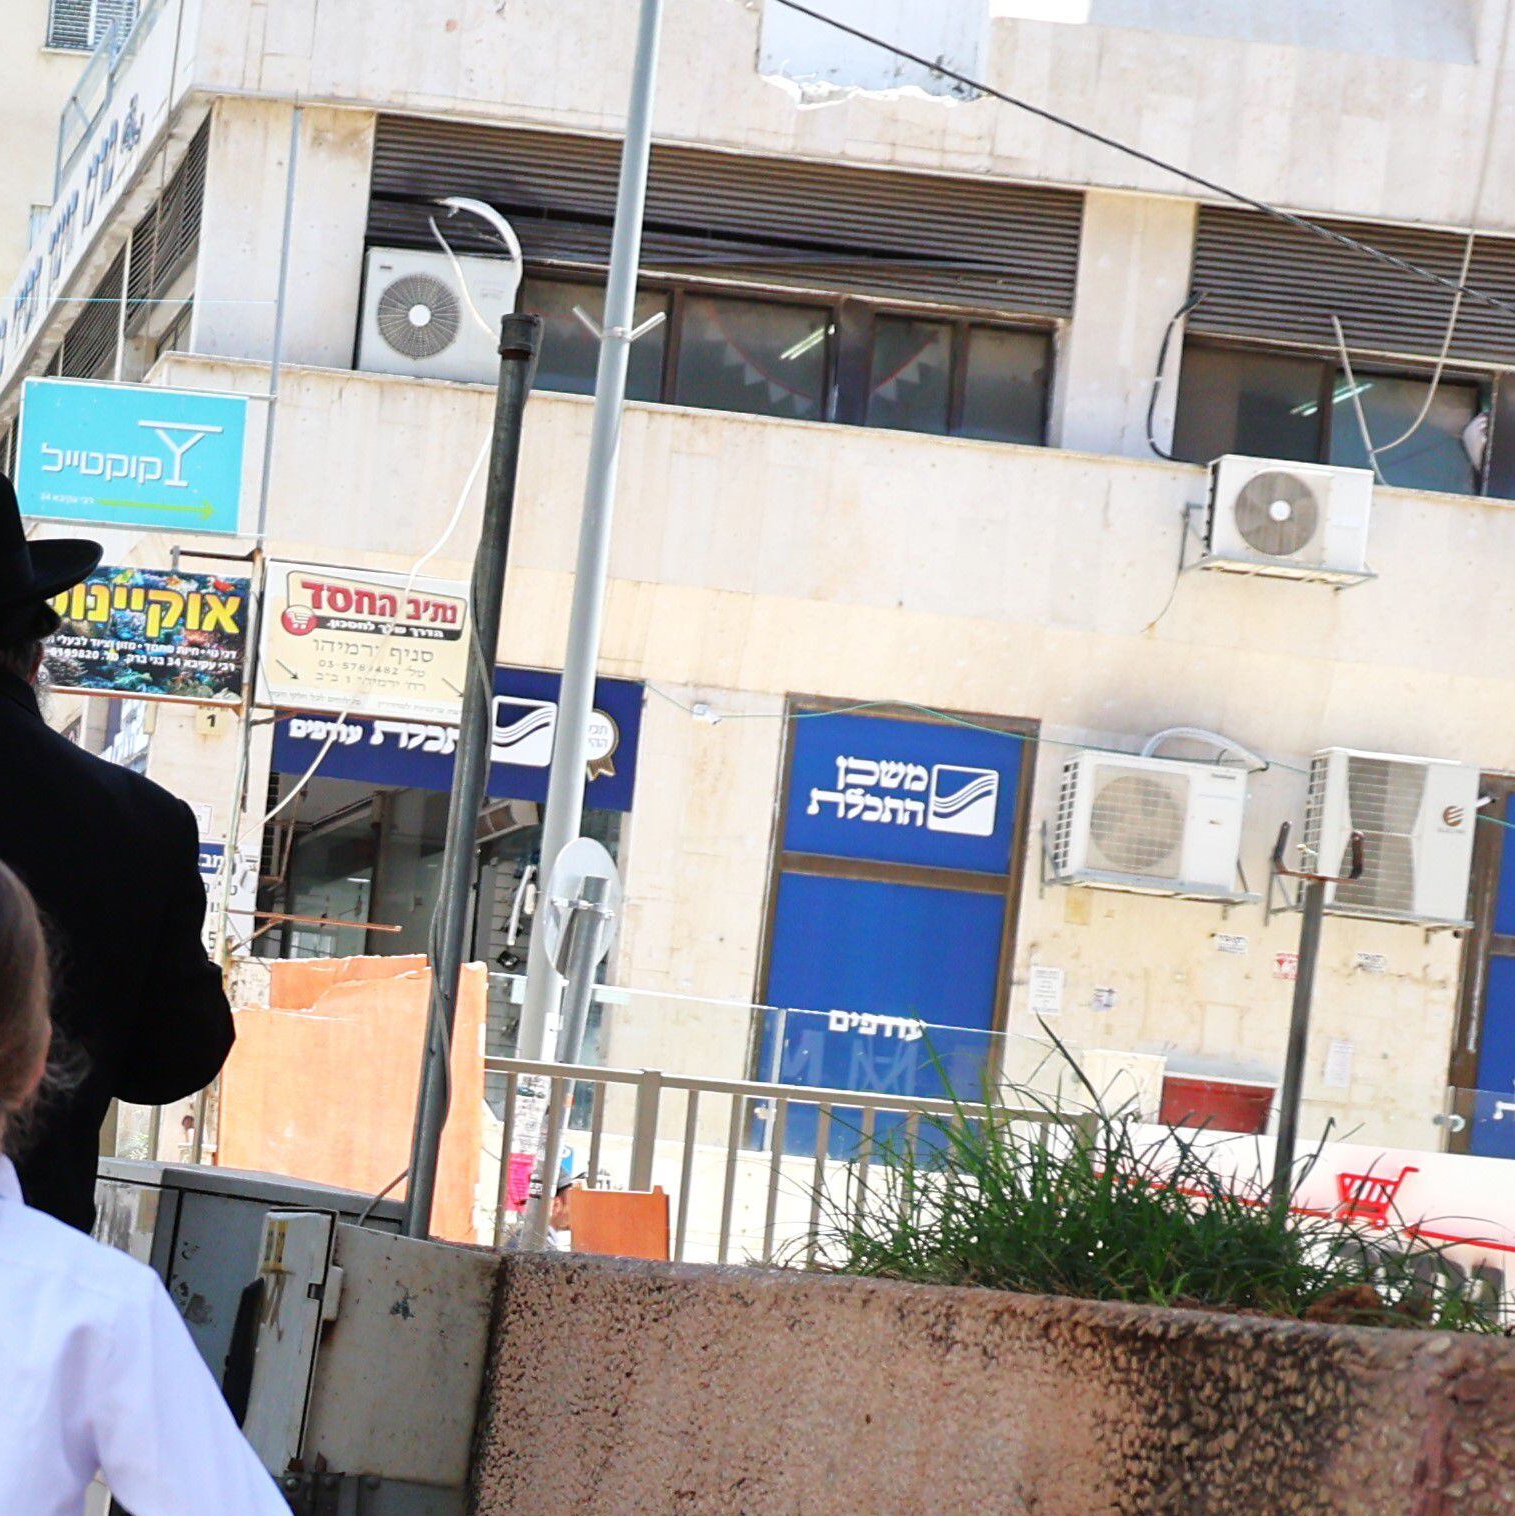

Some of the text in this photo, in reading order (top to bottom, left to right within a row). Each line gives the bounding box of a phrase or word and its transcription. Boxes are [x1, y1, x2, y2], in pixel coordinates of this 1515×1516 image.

[41, 441, 163, 484] קוקטייל
[301, 578, 458, 625] נתיב החסד
[56, 634, 89, 646] לבעלי
[313, 638, 434, 665] סניף ירמיהו
[166, 656, 181, 667] 34
[182, 659, 217, 671] עקיבא
[217, 662, 236, 672] רבי
[206, 713, 217, 729] 1
[288, 717, 363, 746] עודפים
[835, 754, 930, 792] משכן
[806, 787, 926, 827] התכלת
[828, 1009, 924, 1042] עודפים
